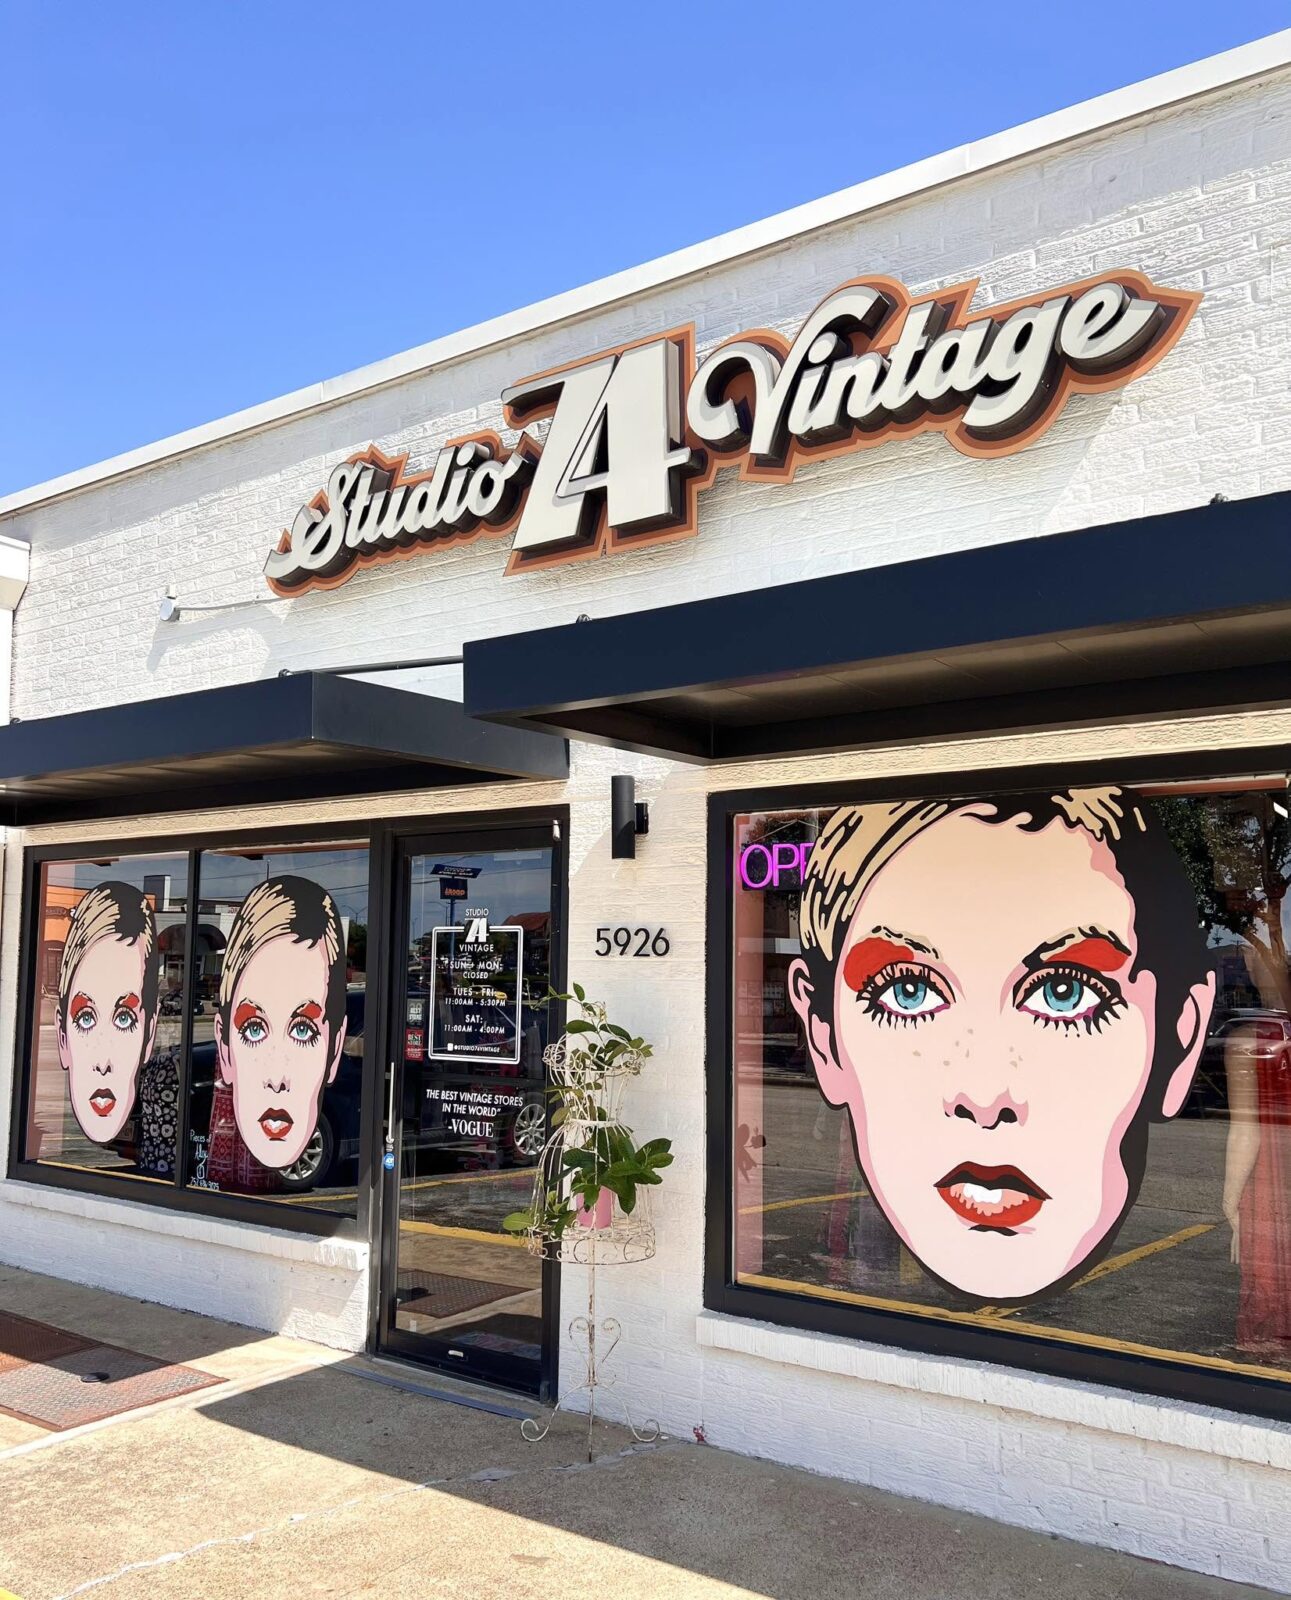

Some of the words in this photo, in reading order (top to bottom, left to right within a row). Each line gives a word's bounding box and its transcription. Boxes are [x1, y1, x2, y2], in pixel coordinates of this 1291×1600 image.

[265, 440, 524, 583] Studio
[502, 338, 691, 552] 74
[688, 281, 1165, 459] Vintage
[465, 908, 489, 916] STUDIO
[465, 918, 489, 942] 74
[594, 927, 670, 957] 5926
[459, 944, 494, 952] VINTAGE
[450, 961, 466, 969] SUN
[478, 961, 503, 970] MON:
[453, 988, 472, 996] TUES
[482, 988, 496, 996] FRI:
[465, 1015, 483, 1023] SAT:
[480, 1026, 505, 1034] 4:00PM
[426, 1089, 439, 1099] THE
[441, 1090, 458, 1100] BEST
[460, 1092, 492, 1103] VINTAGE
[494, 1095, 523, 1106] STORES
[442, 1103, 451, 1112] IN
[453, 1104, 467, 1114] THE
